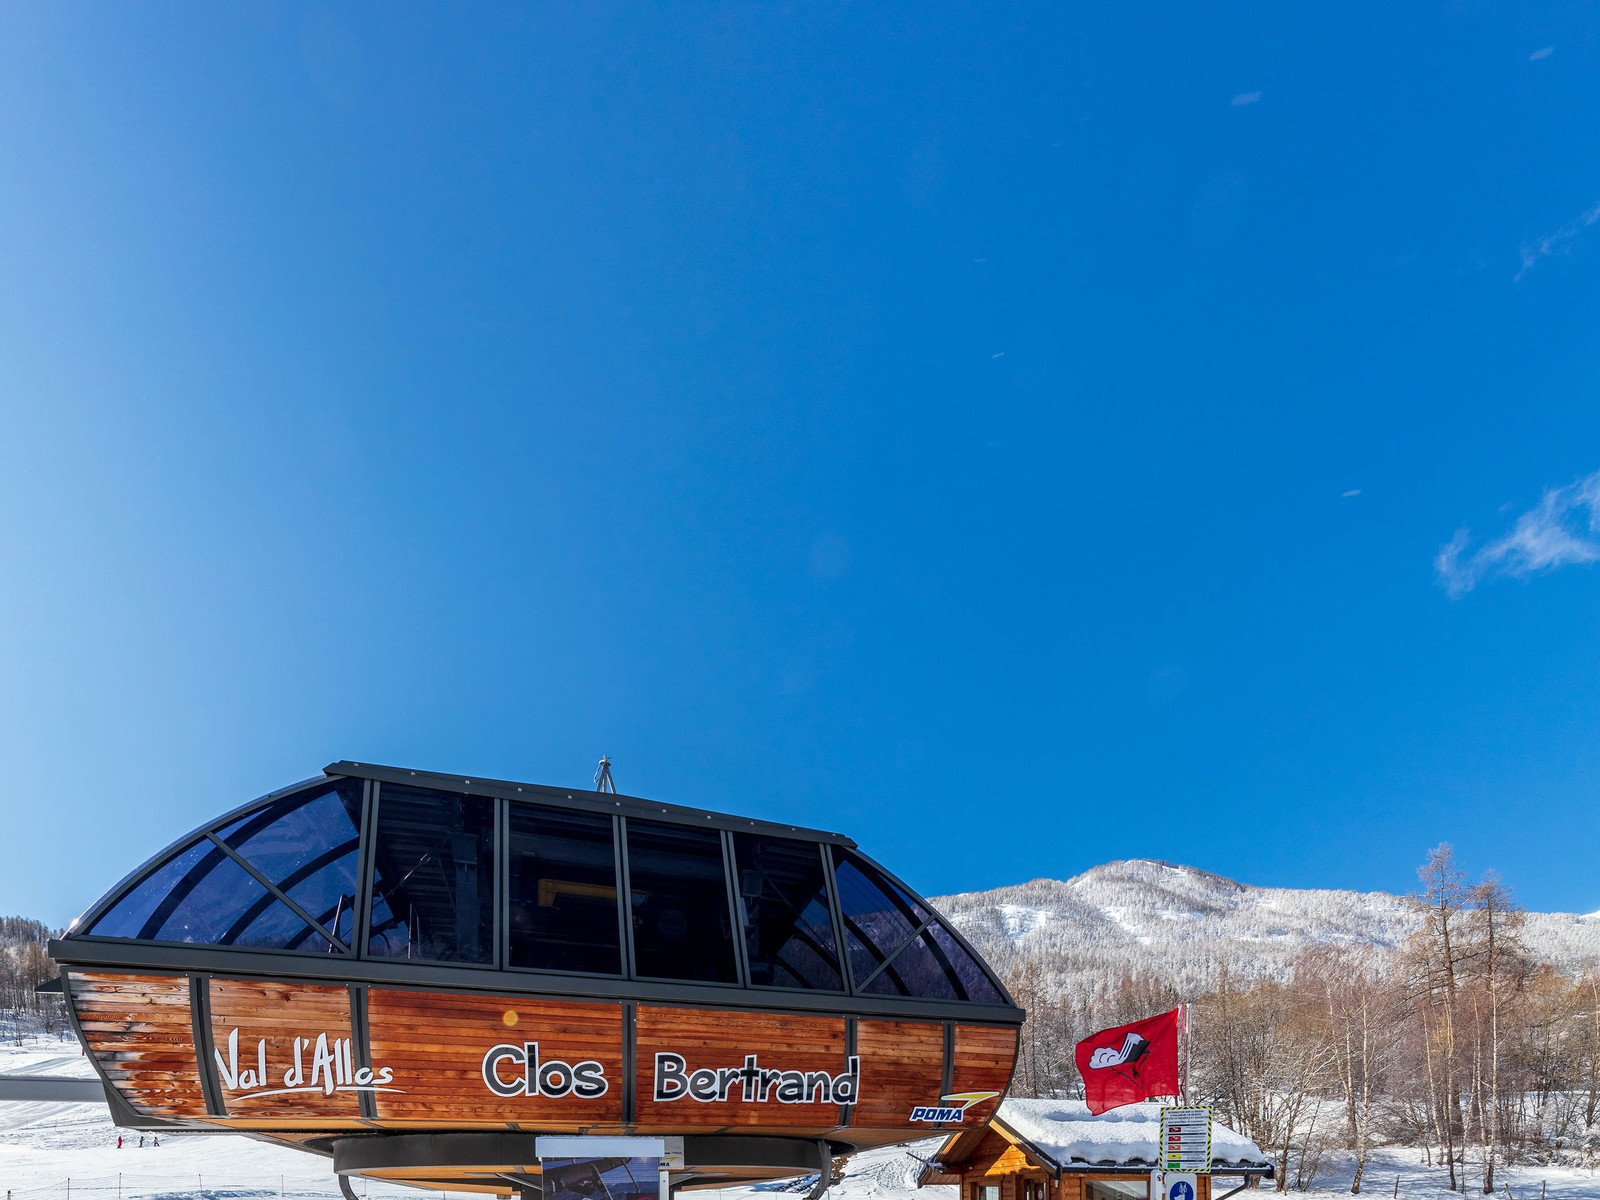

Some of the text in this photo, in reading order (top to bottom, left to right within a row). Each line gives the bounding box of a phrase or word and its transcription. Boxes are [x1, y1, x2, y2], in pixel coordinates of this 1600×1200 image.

[214, 1027, 394, 1096] Val d'Allos
[482, 1041, 861, 1105] Clos Bertrand
[909, 1106, 964, 1122] POMA
